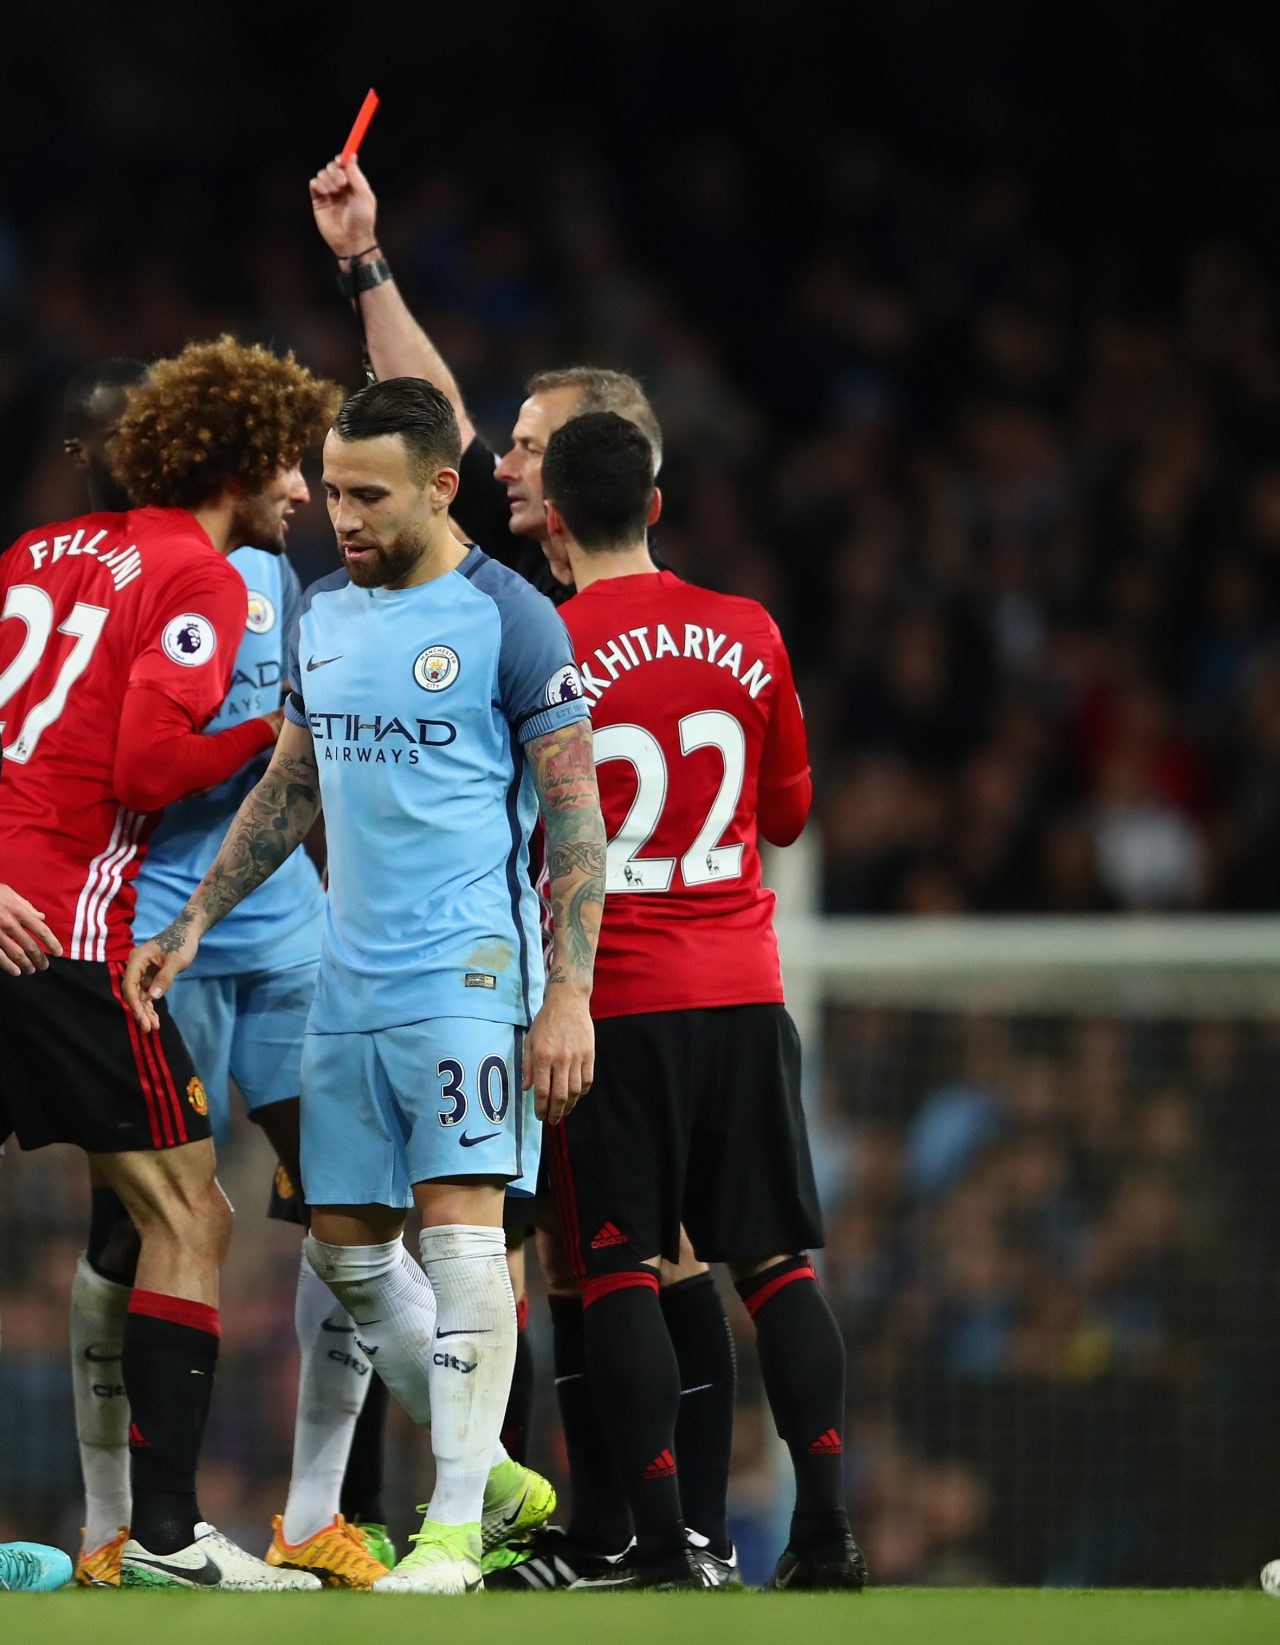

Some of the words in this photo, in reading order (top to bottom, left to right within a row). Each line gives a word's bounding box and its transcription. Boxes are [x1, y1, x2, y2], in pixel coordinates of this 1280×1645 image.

[420, 648, 457, 664] MANCHESTER
[581, 623, 773, 709] KHITARYAN
[308, 712, 458, 748] ETIHAD
[324, 747, 420, 765] AIRWAYS
[591, 709, 747, 895] 22
[436, 1053, 510, 1127] 30
